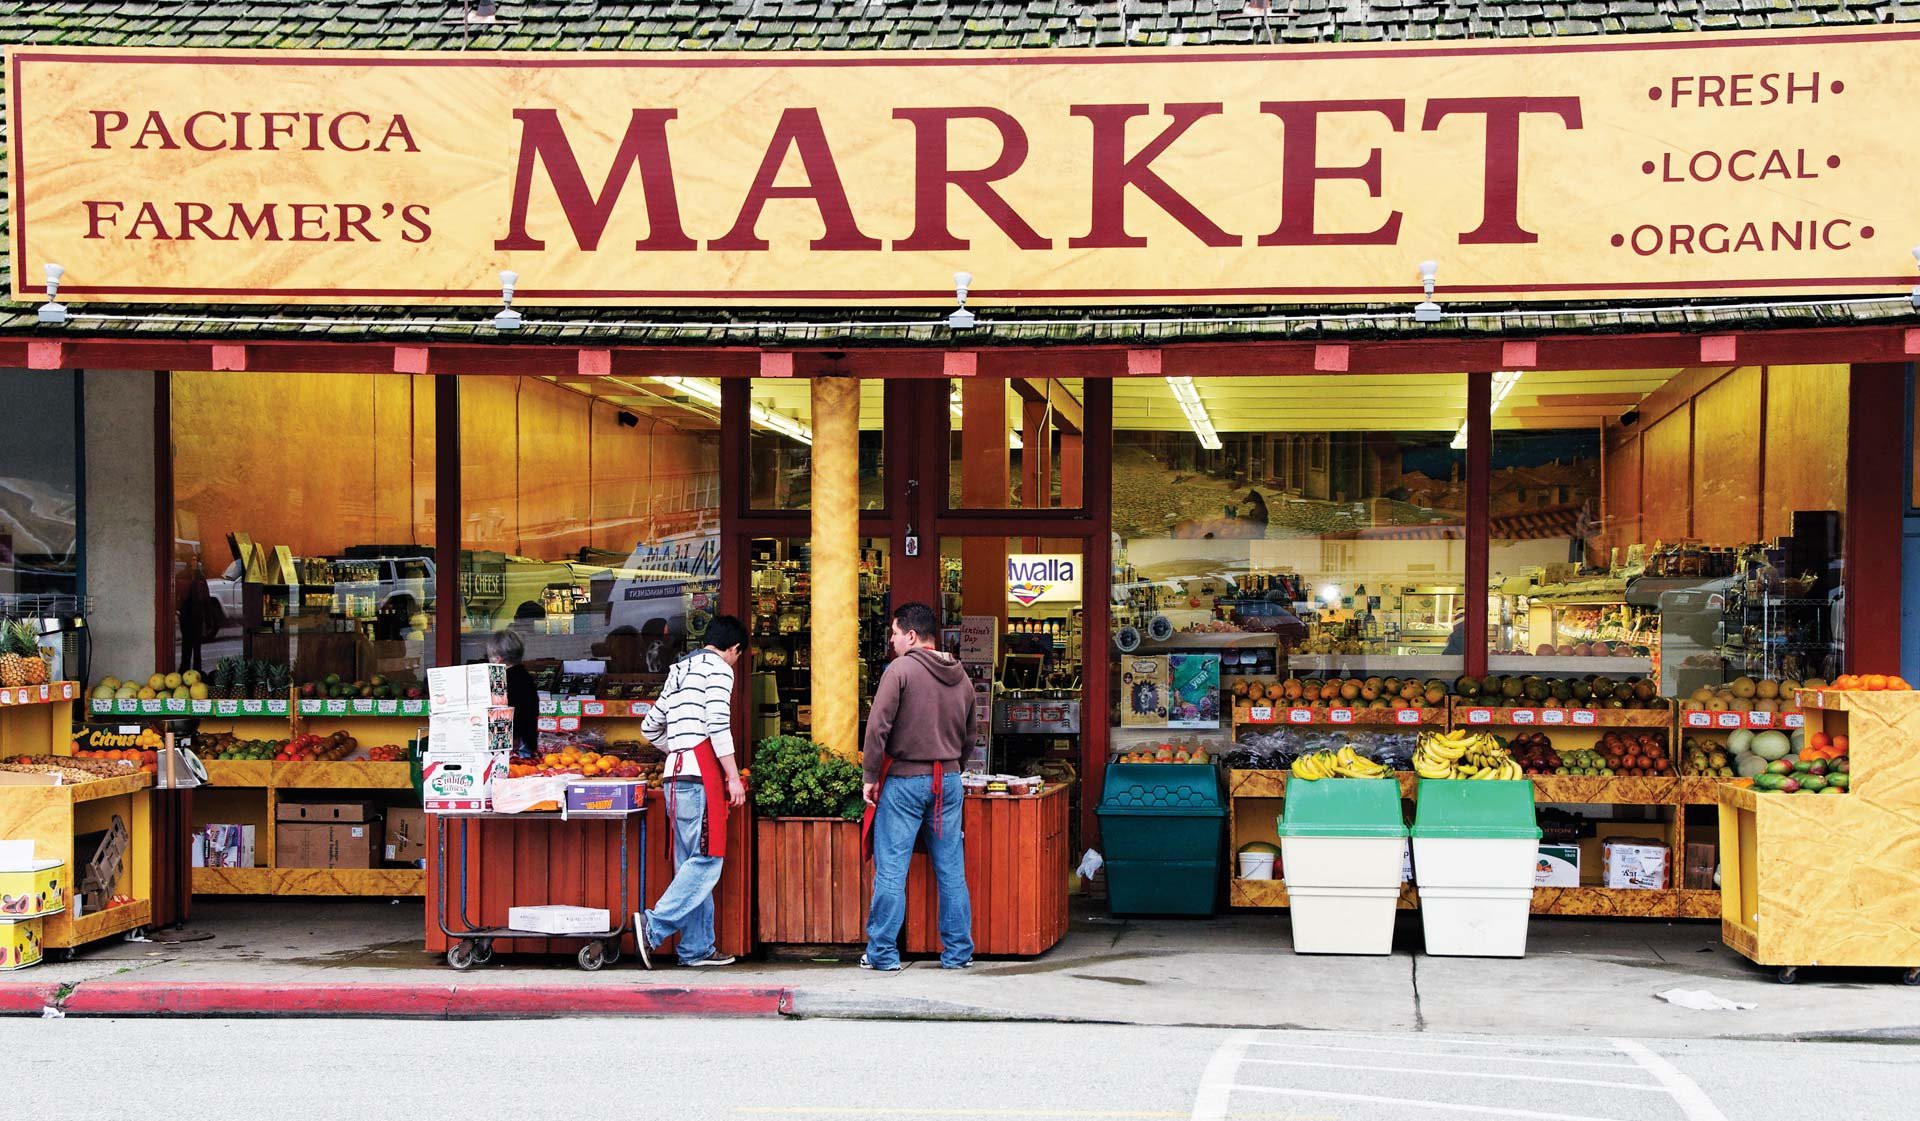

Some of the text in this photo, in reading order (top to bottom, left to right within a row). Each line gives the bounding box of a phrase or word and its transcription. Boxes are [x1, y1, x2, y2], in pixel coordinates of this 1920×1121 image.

[1671, 72, 1819, 108] FRESH
[89, 110, 420, 153] PACIFICA
[495, 96, 1583, 252] MARKET
[1663, 148, 1818, 183] LOCAL
[82, 201, 432, 244] FARMER'S
[1631, 219, 1851, 256] ORGANIC
[474, 574, 500, 593] CHEESE
[964, 635, 978, 645] Day
[1191, 671, 1209, 689] year
[90, 729, 136, 747] Citrus
